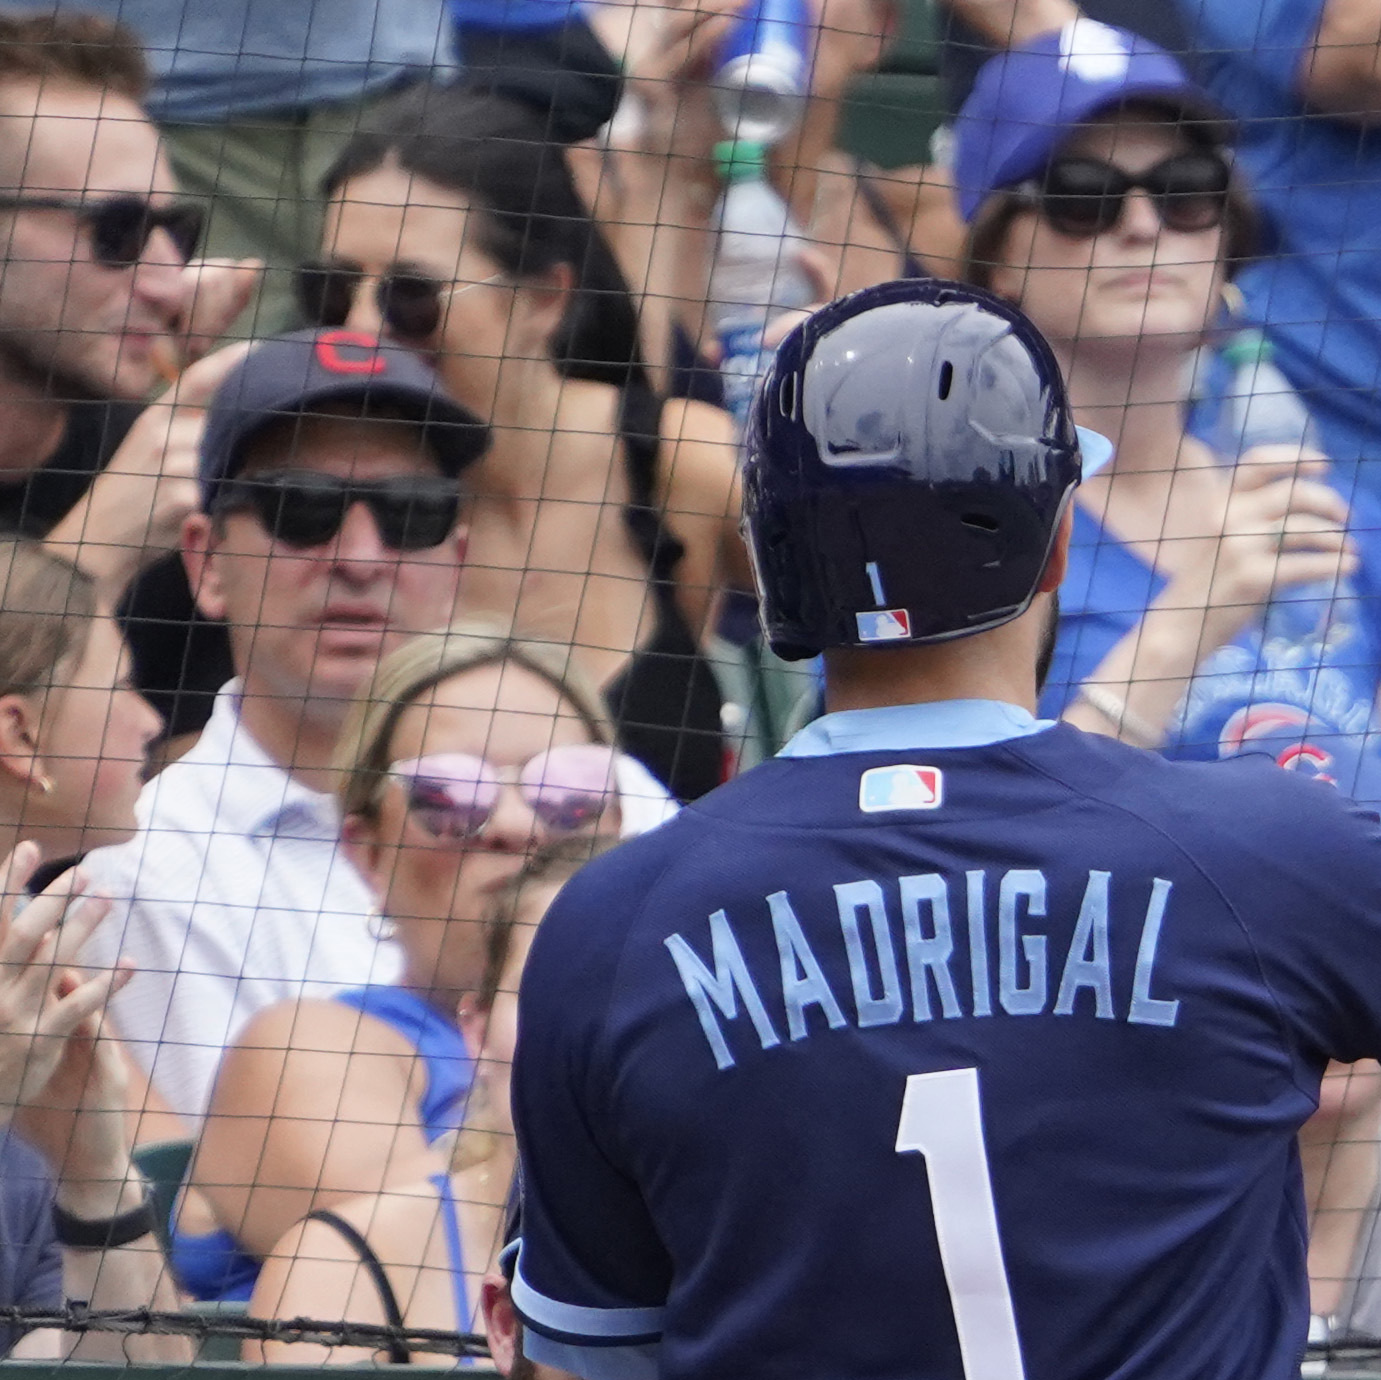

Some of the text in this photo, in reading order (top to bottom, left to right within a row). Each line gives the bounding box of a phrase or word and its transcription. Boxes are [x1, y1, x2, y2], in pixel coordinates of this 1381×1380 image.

[315, 330, 386, 375] C
[865, 561, 886, 607] 1
[664, 869, 1181, 1071] MADRIGAL
